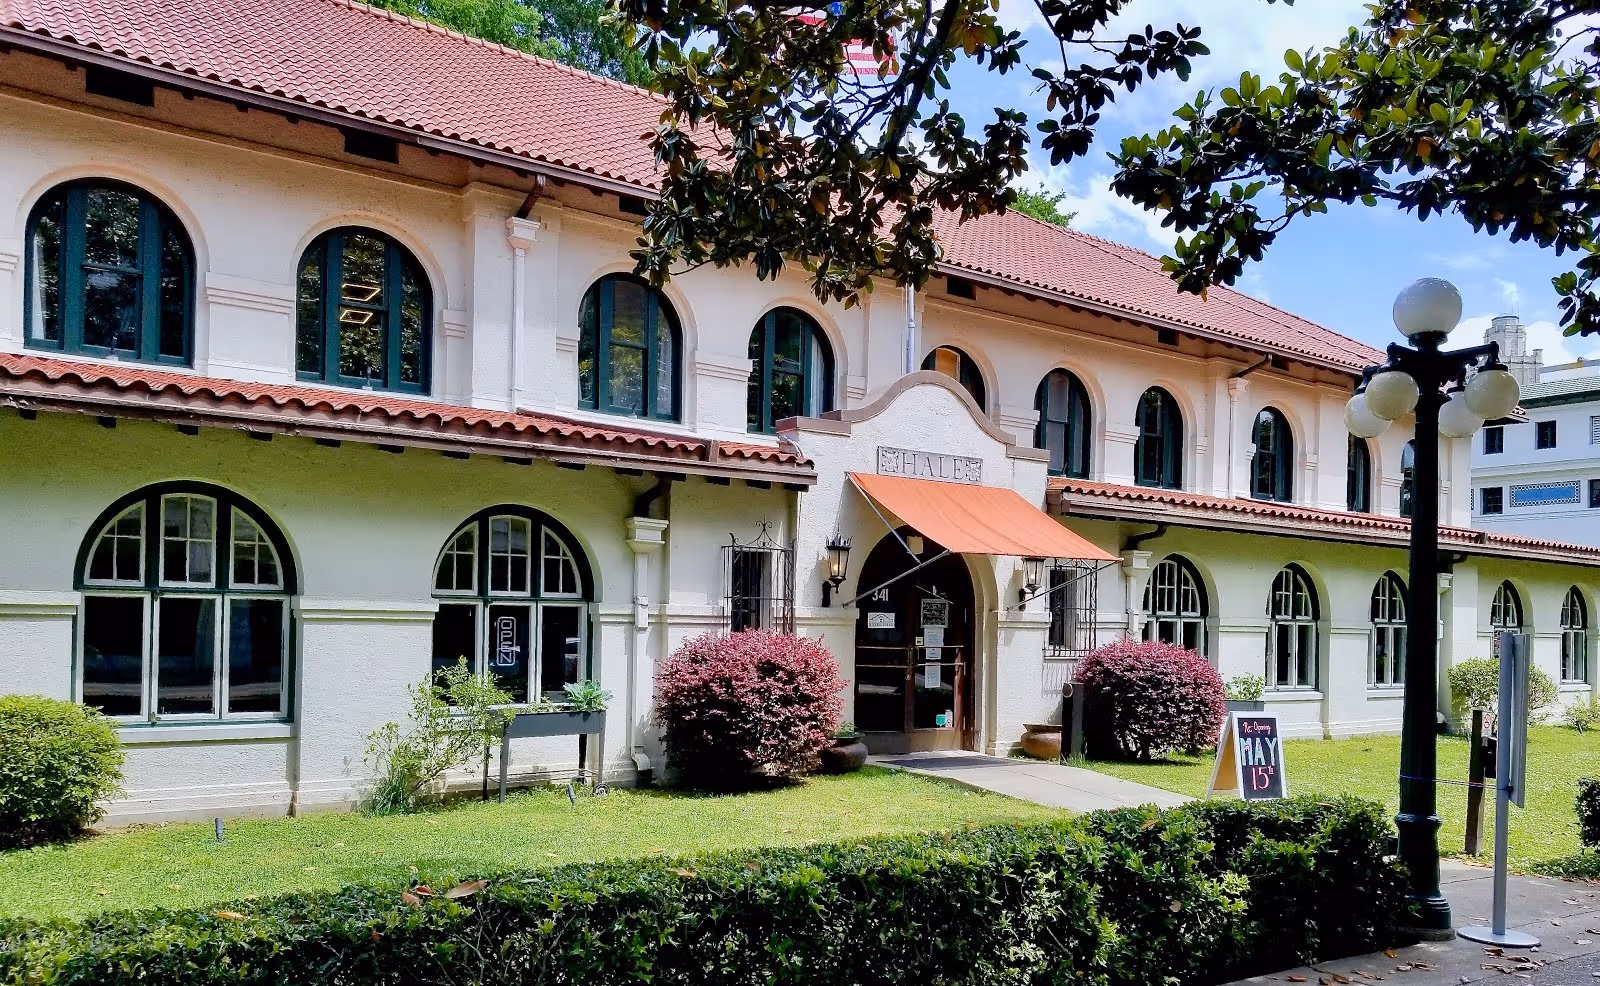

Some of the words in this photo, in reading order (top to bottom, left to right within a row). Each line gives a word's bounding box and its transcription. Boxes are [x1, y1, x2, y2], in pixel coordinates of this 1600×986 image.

[901, 452, 964, 480] HALE
[871, 588, 889, 602] 341
[500, 620, 513, 664] OPEN
[1240, 737, 1277, 766] MAY
